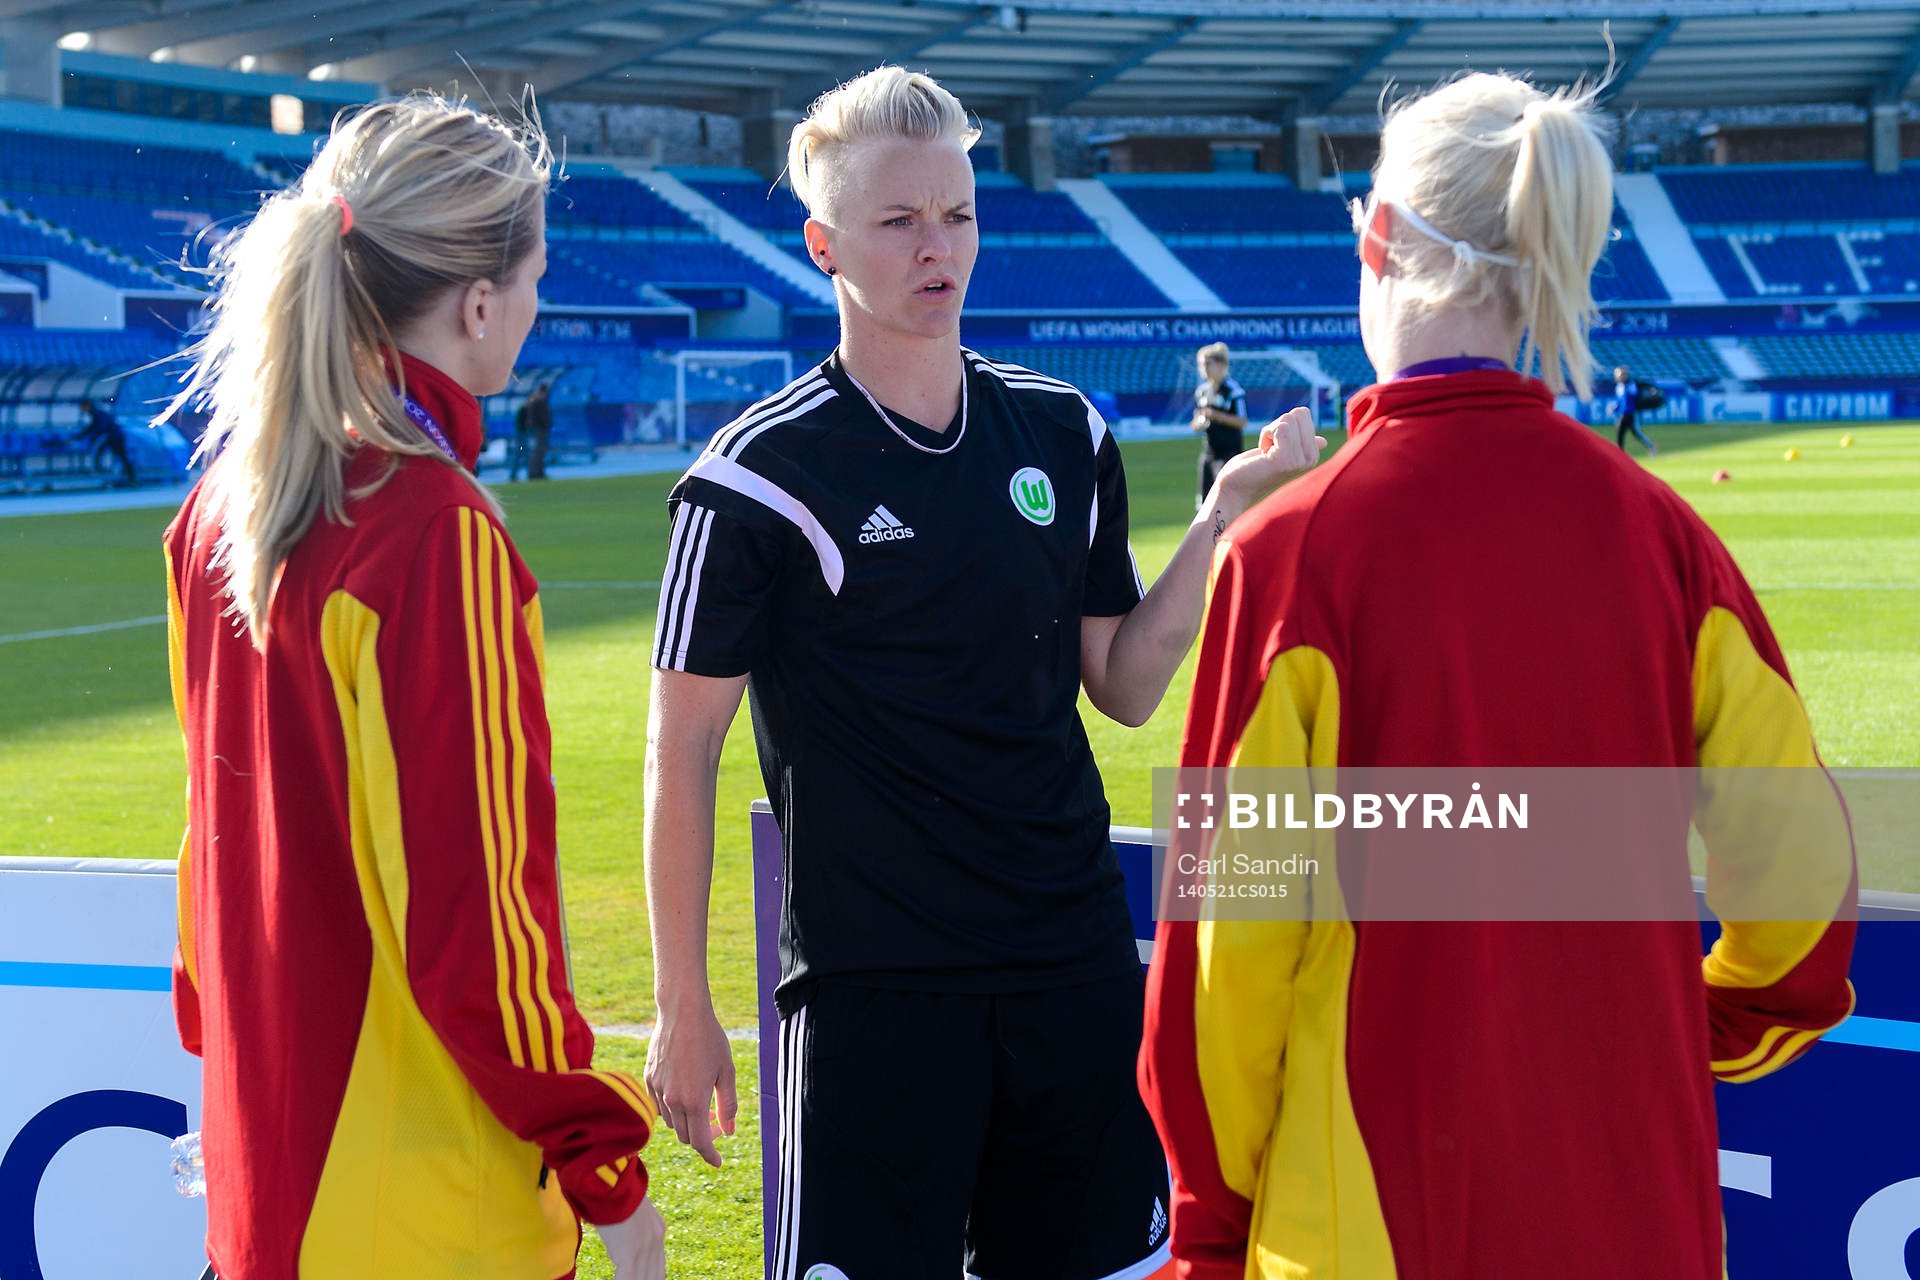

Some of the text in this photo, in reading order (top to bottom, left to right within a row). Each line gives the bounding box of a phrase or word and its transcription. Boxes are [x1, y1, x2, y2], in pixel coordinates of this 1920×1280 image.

[1030, 317, 1358, 341] UEFA WOMEN'S CHAMPIONS LEAGUE
[858, 526, 915, 544] adidas
